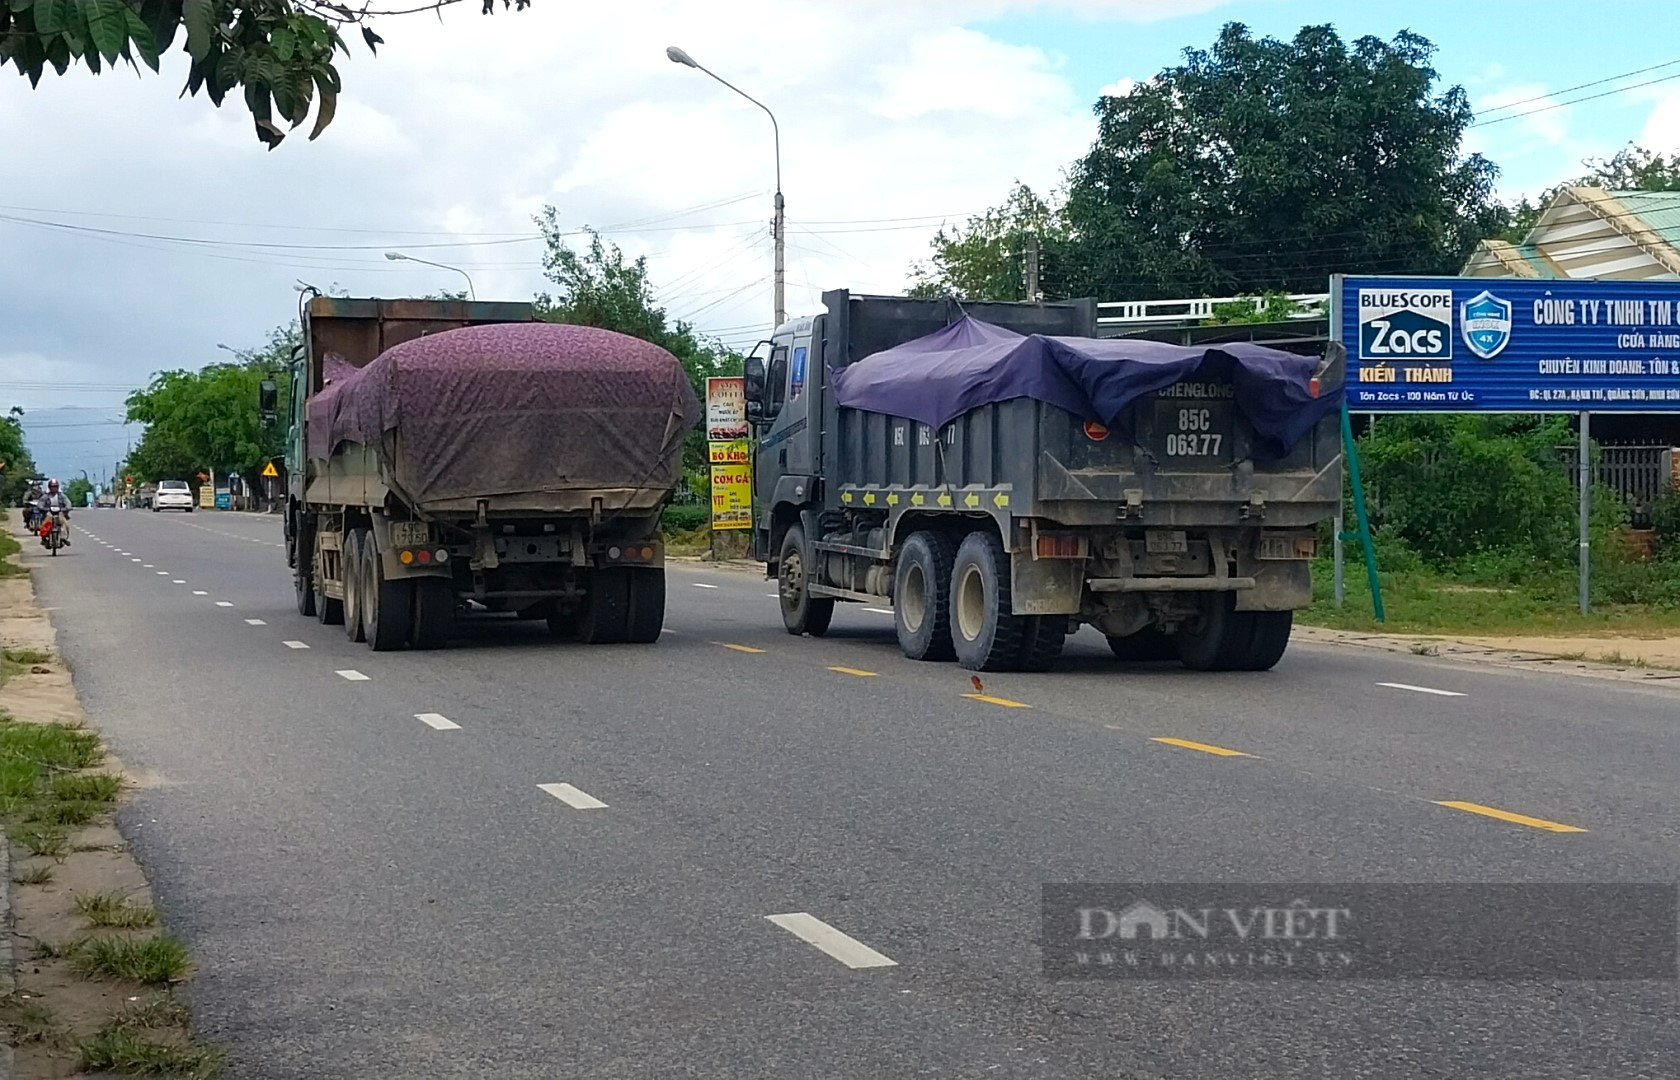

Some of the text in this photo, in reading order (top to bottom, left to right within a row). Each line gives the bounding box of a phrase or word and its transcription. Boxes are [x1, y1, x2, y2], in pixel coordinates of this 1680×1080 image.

[1533, 290, 1671, 325] CÔNG TY TNHH TM
[1370, 321, 1442, 353] Zacs
[1649, 331, 1680, 348] HÀNG
[1359, 361, 1452, 382] KIẾN THÀNH
[1539, 357, 1580, 374] CHUYÊN
[1583, 360, 1607, 374] KINH
[1609, 360, 1646, 374] DOANH:
[1649, 357, 1669, 374] TÔN
[1178, 409, 1210, 430] 85C
